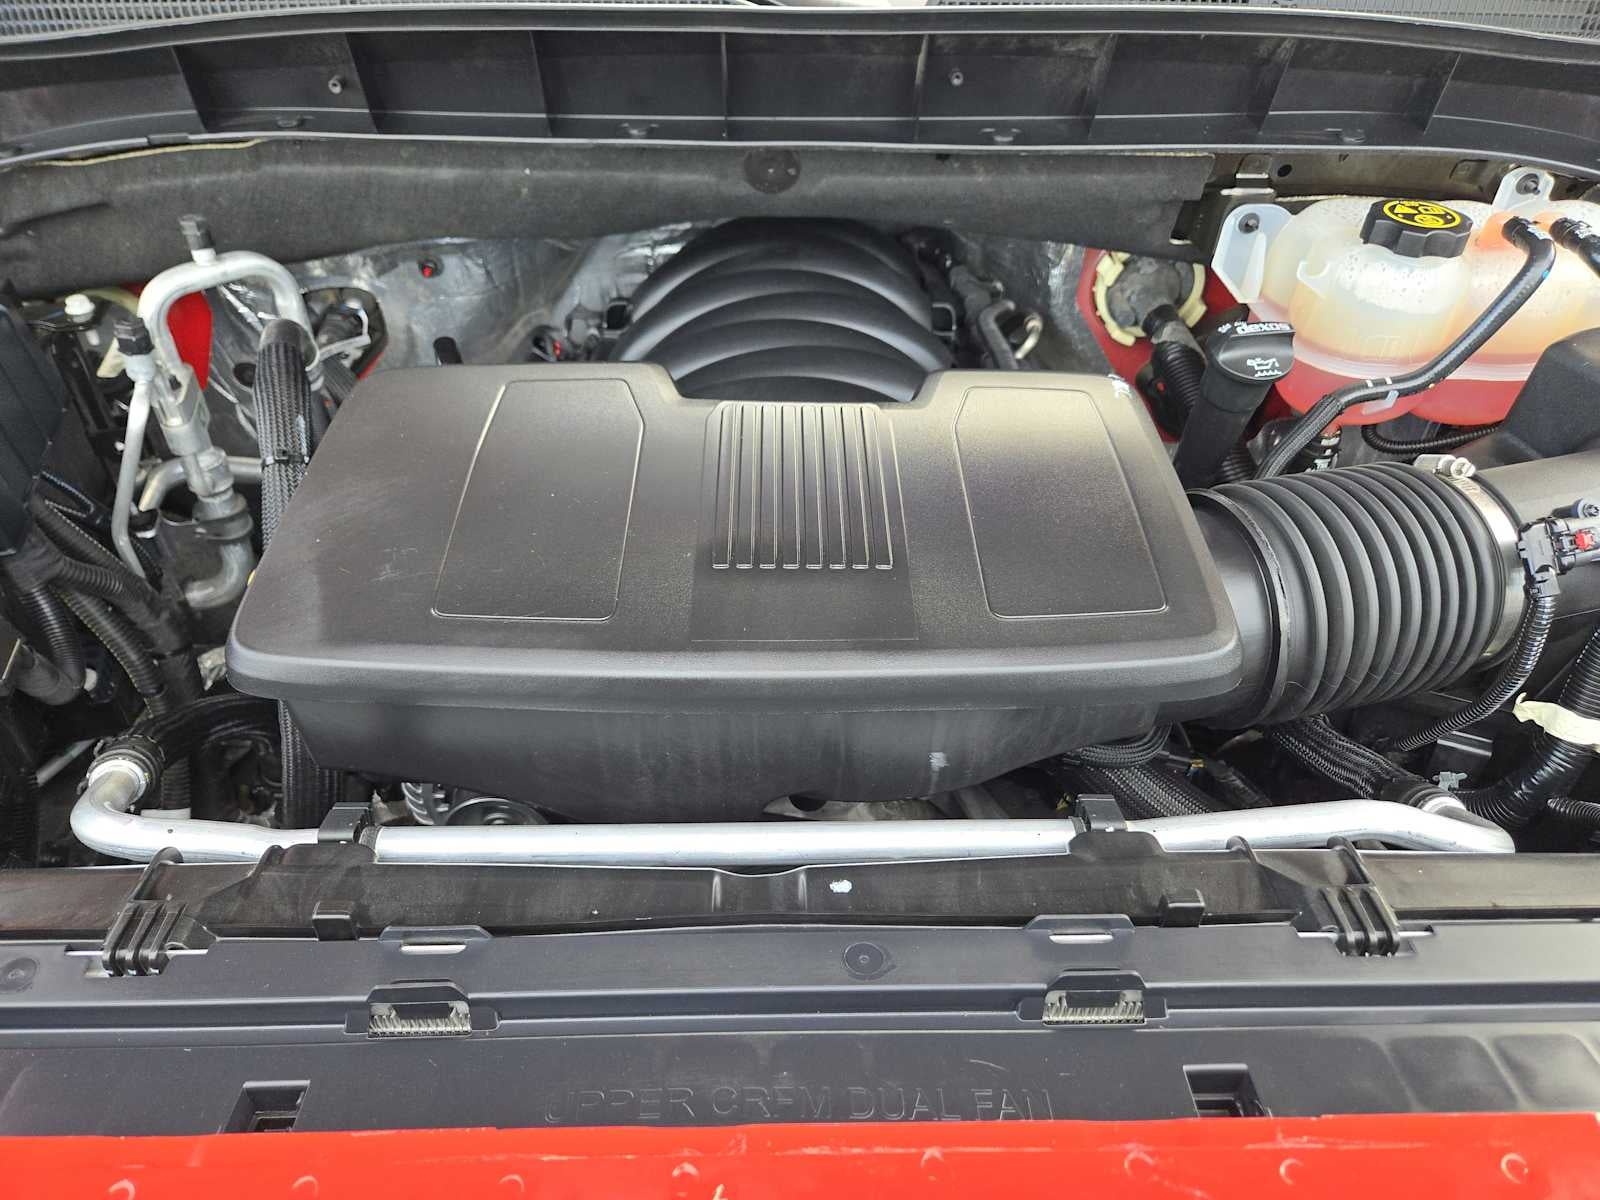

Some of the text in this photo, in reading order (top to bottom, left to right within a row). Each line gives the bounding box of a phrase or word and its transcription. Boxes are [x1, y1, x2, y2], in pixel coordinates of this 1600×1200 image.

[544, 1087, 696, 1123] UPPER
[847, 1086, 961, 1121] DUAL
[971, 1088, 1055, 1122] FAN
